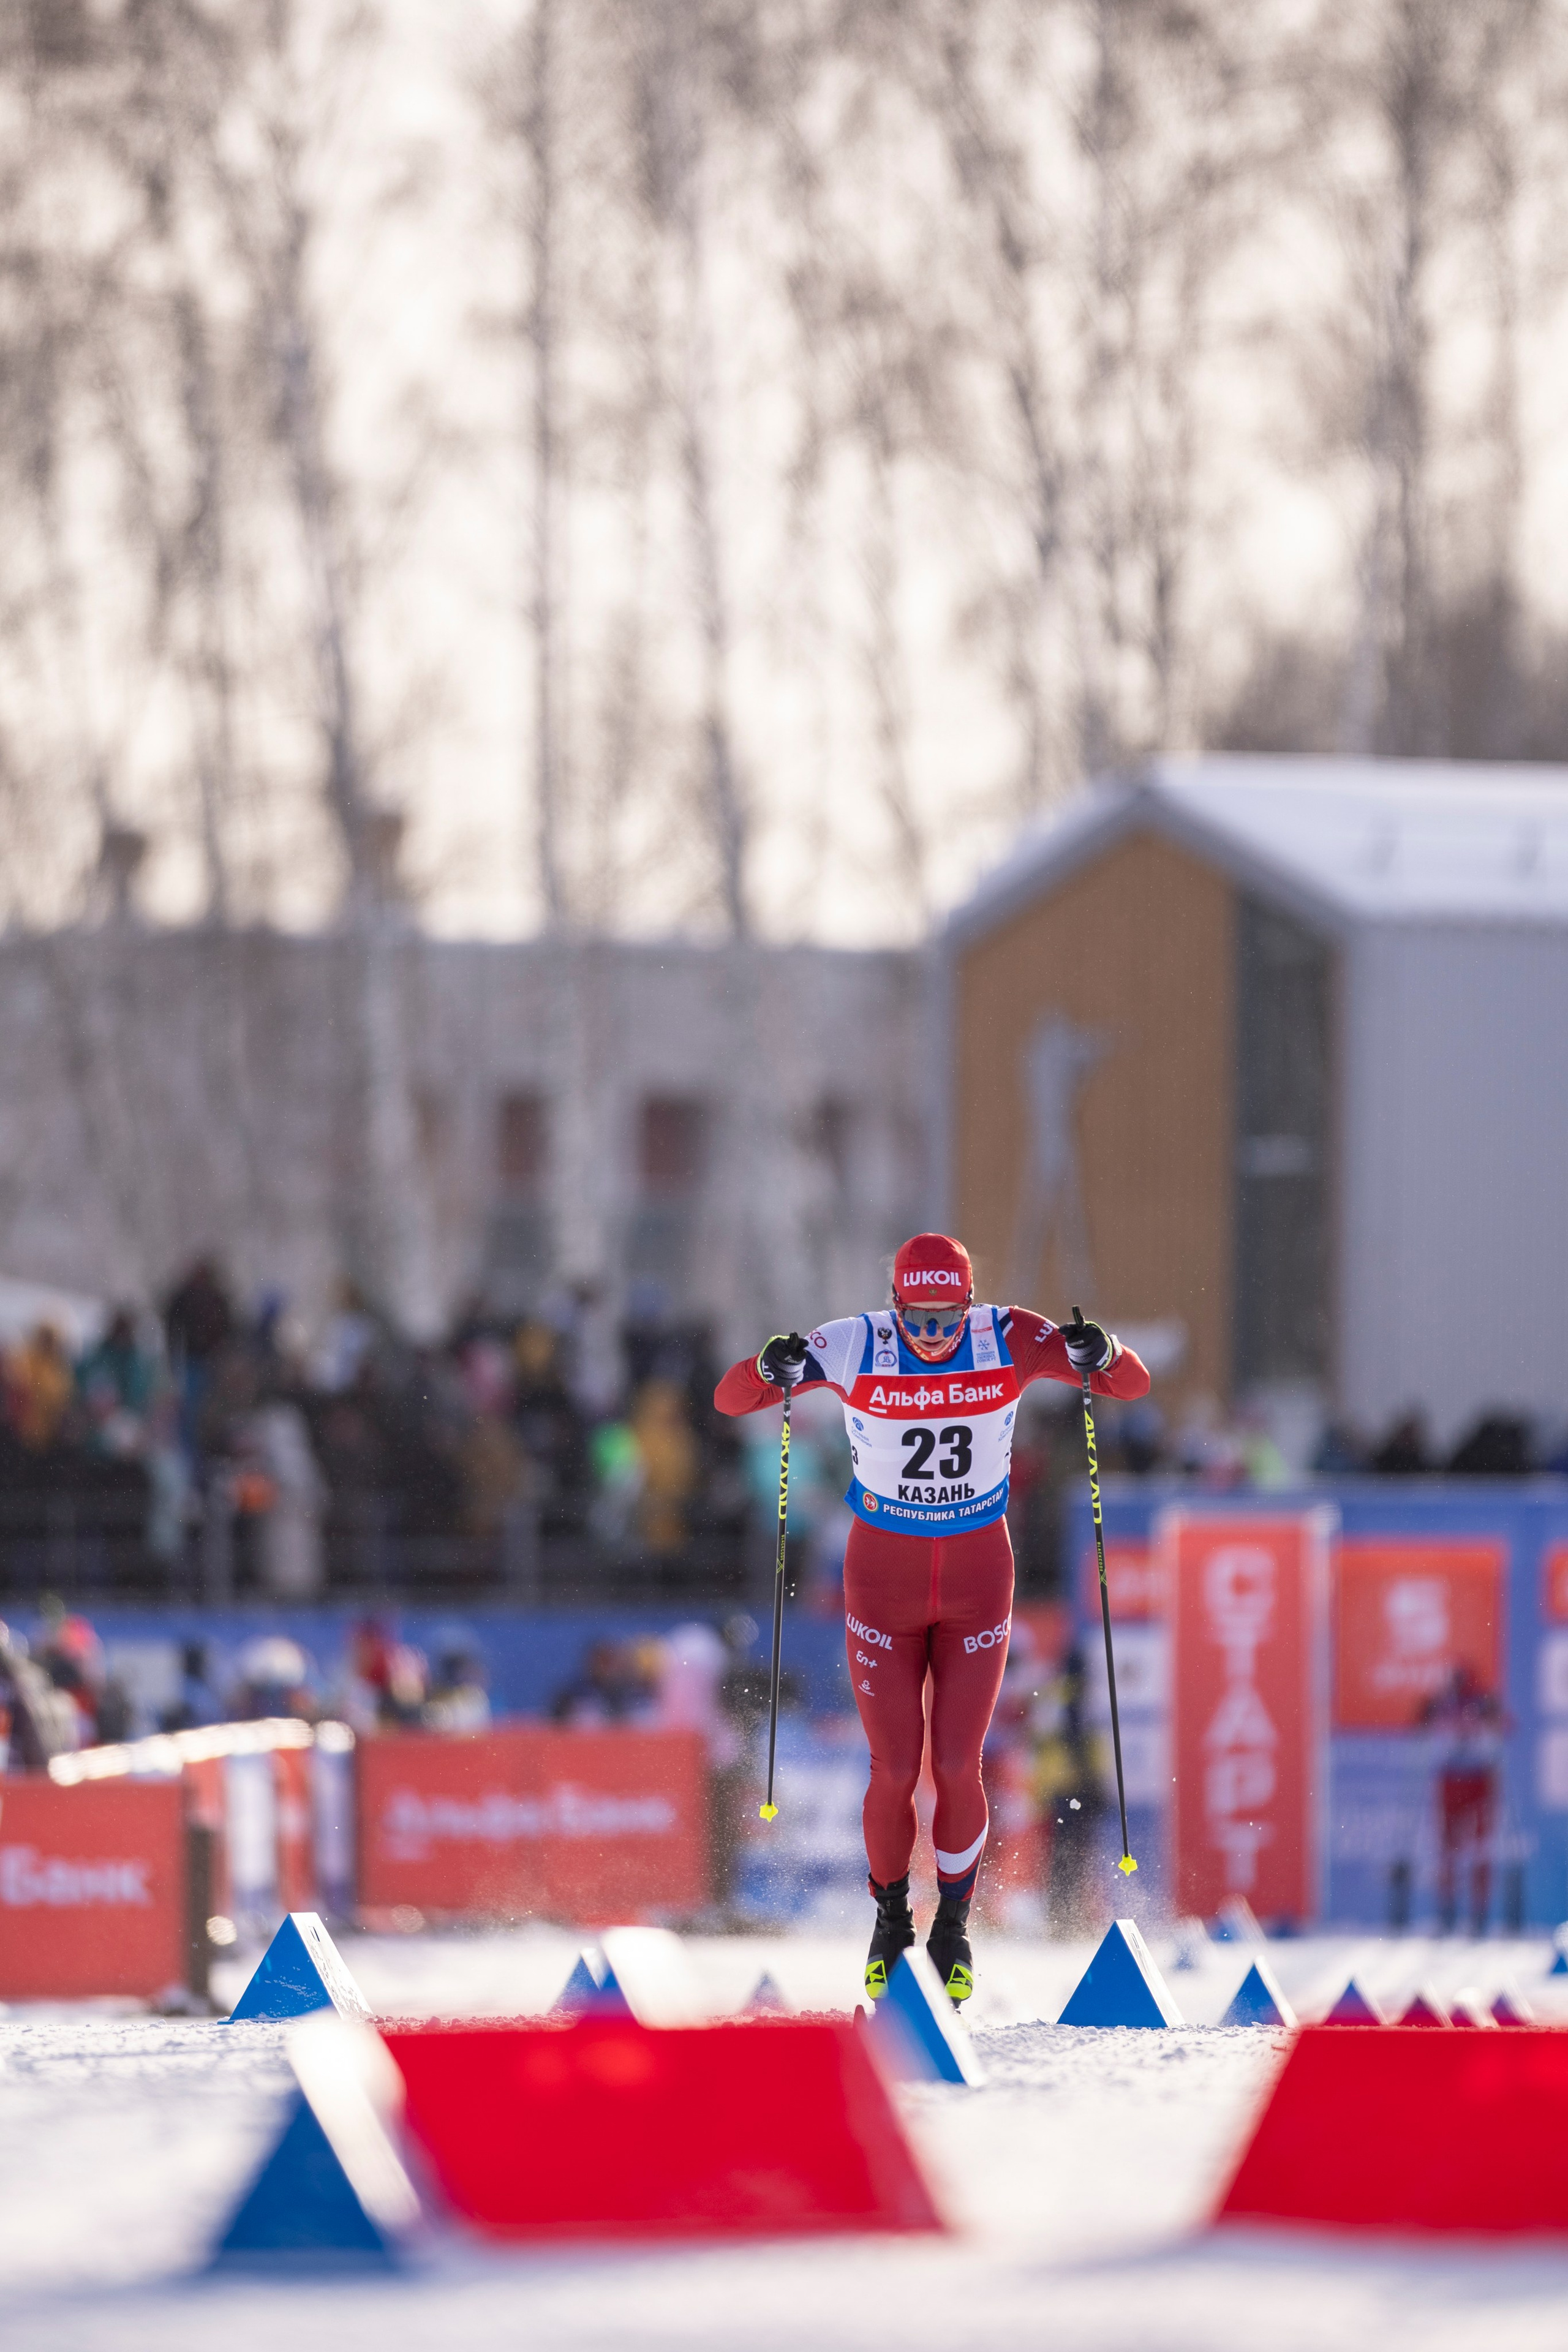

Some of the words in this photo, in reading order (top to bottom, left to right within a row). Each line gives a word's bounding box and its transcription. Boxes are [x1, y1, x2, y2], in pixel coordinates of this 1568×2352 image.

[903, 1270, 962, 1287] LUKOIL
[807, 1329, 827, 1349] CO
[869, 1385, 944, 1411] Альфа
[949, 1383, 1004, 1404] Банк
[902, 1425, 973, 1480] 23
[898, 1483, 975, 1504] КАЗАНЬ
[883, 1503, 956, 1521] РЕСПУБЛИКА
[846, 1612, 892, 1651] LUKOIL
[856, 1650, 878, 1668] En+
